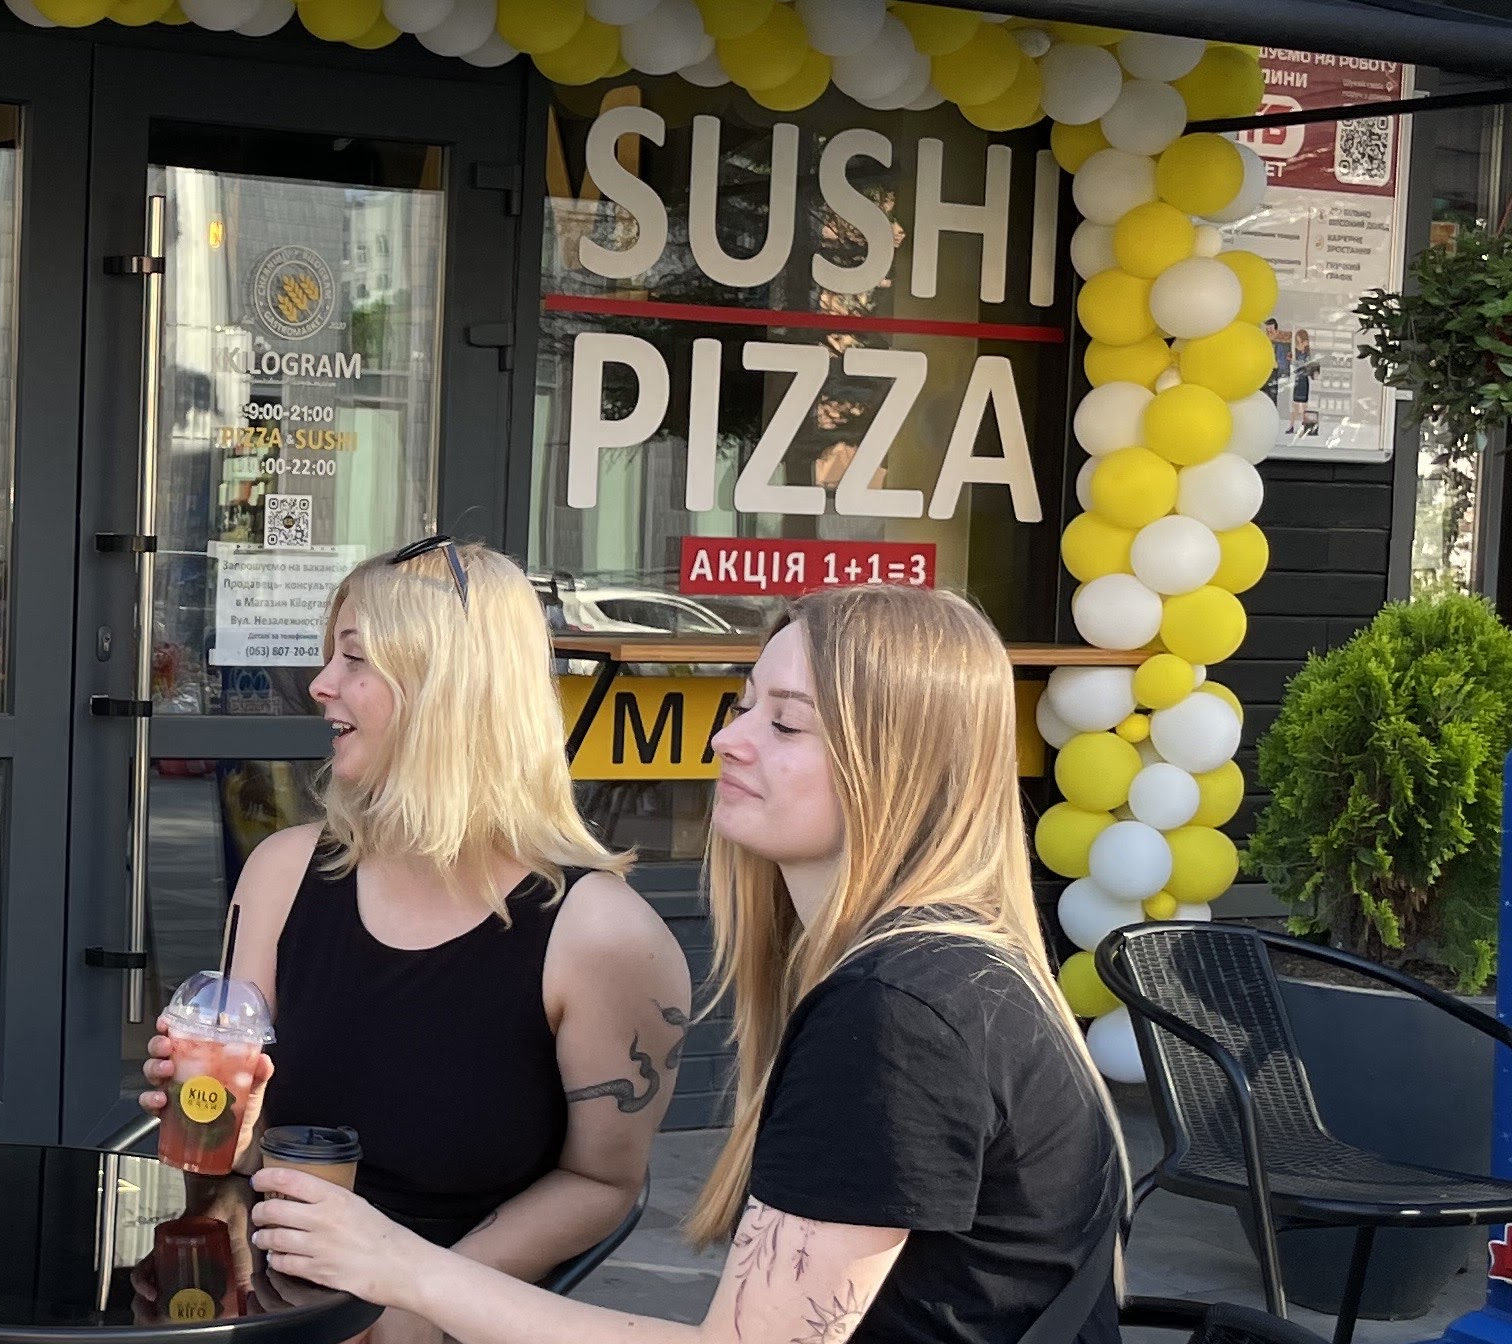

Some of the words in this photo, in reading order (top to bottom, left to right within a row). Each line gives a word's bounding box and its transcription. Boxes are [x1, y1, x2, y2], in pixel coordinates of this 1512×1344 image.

[1339, 56, 1398, 74] РОБОТУ
[578, 105, 1061, 308] SUSHI
[295, 429, 358, 452] SUSHI
[566, 331, 1044, 524] PIZZA
[689, 549, 806, 590] АКЦІЯ
[823, 552, 926, 586] 1+1=3
[188, 1087, 218, 1104] KILO
